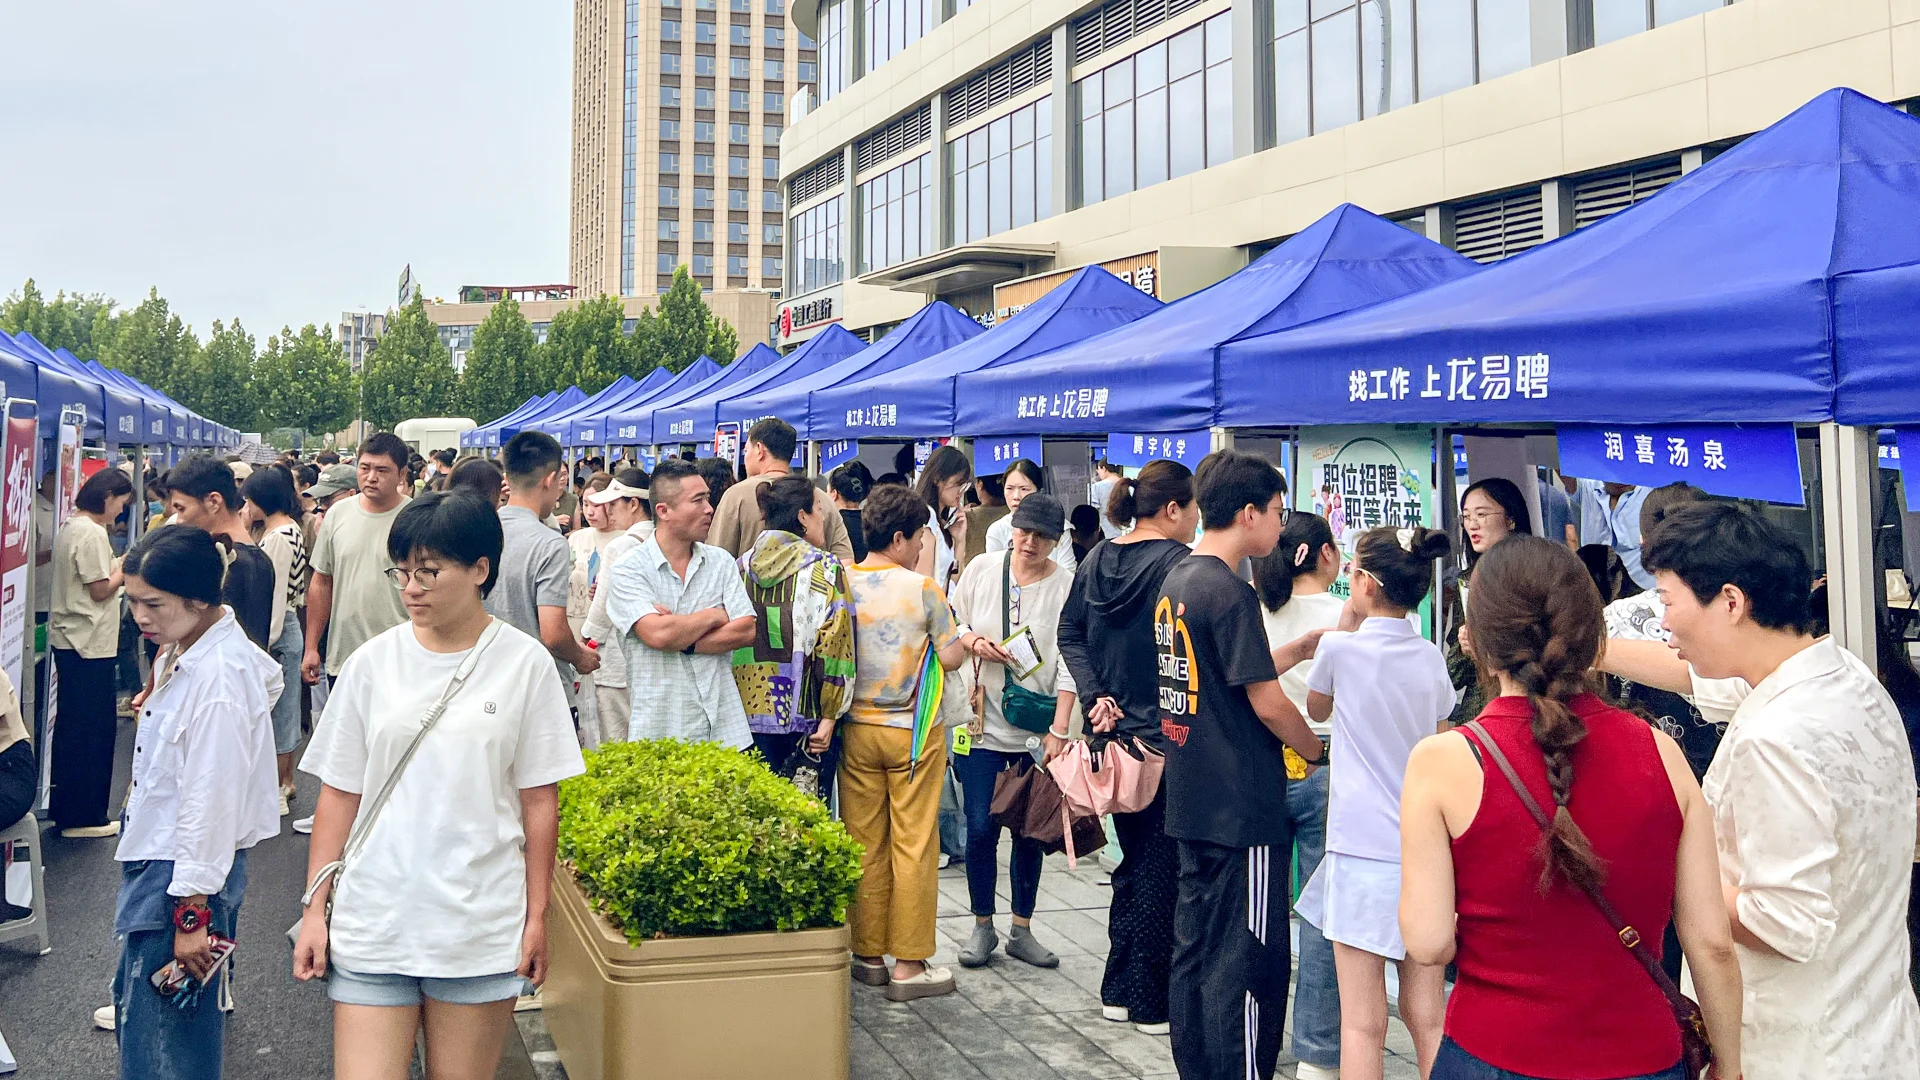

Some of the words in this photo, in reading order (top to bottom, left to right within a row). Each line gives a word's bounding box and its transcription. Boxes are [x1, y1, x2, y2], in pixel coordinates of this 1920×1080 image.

[792, 297, 832, 327] 中国工商银行
[1349, 367, 1410, 401] 找工作
[1420, 353, 1549, 401] 上龙易聘
[1017, 395, 1047, 418] 找工作
[1049, 387, 1109, 418] 上龙易聘
[1133, 435, 1186, 459] 腾宇化学
[1603, 431, 1727, 470] 润喜汤泉
[1323, 462, 1398, 498] 职位招聘
[1344, 497, 1422, 530] 职等你来
